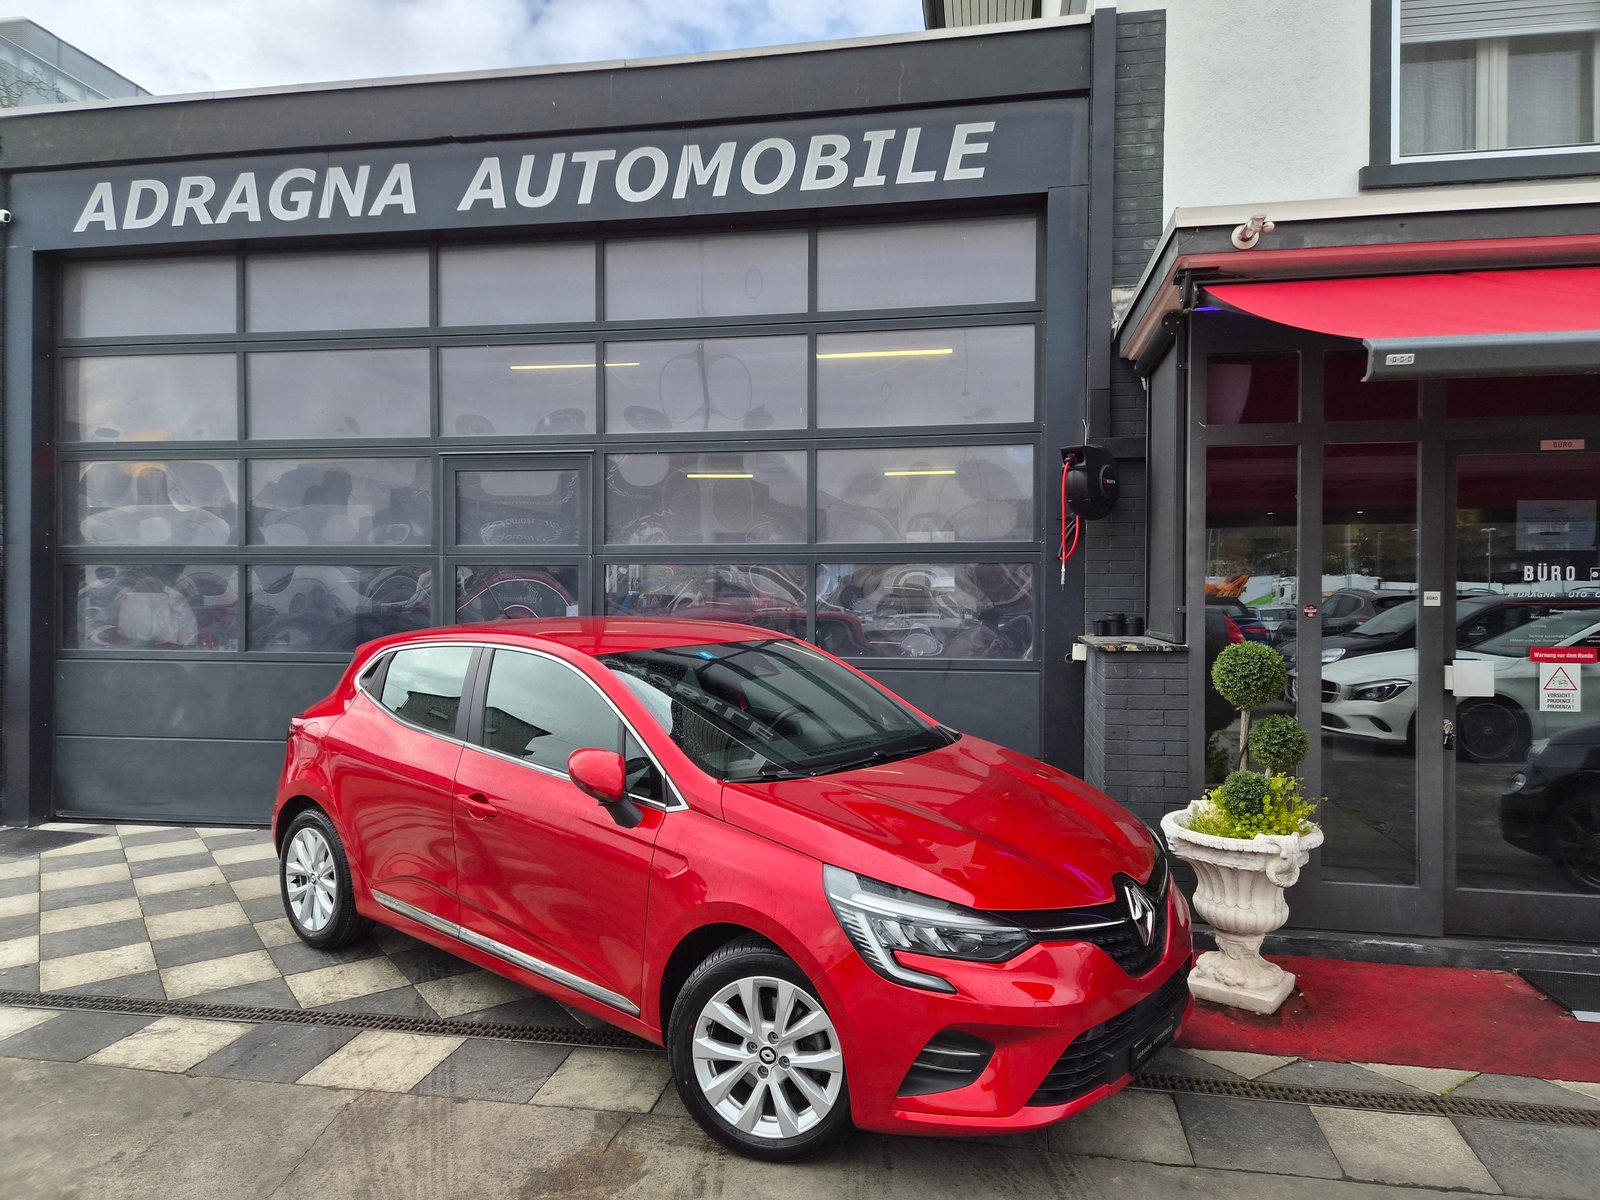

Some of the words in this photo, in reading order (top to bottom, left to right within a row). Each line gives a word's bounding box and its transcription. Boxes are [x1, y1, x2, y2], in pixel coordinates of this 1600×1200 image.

[72, 162, 417, 233] ADRAGNA
[456, 121, 996, 212] AUTOMOBILE
[1523, 563, 1575, 581] BÜRO
